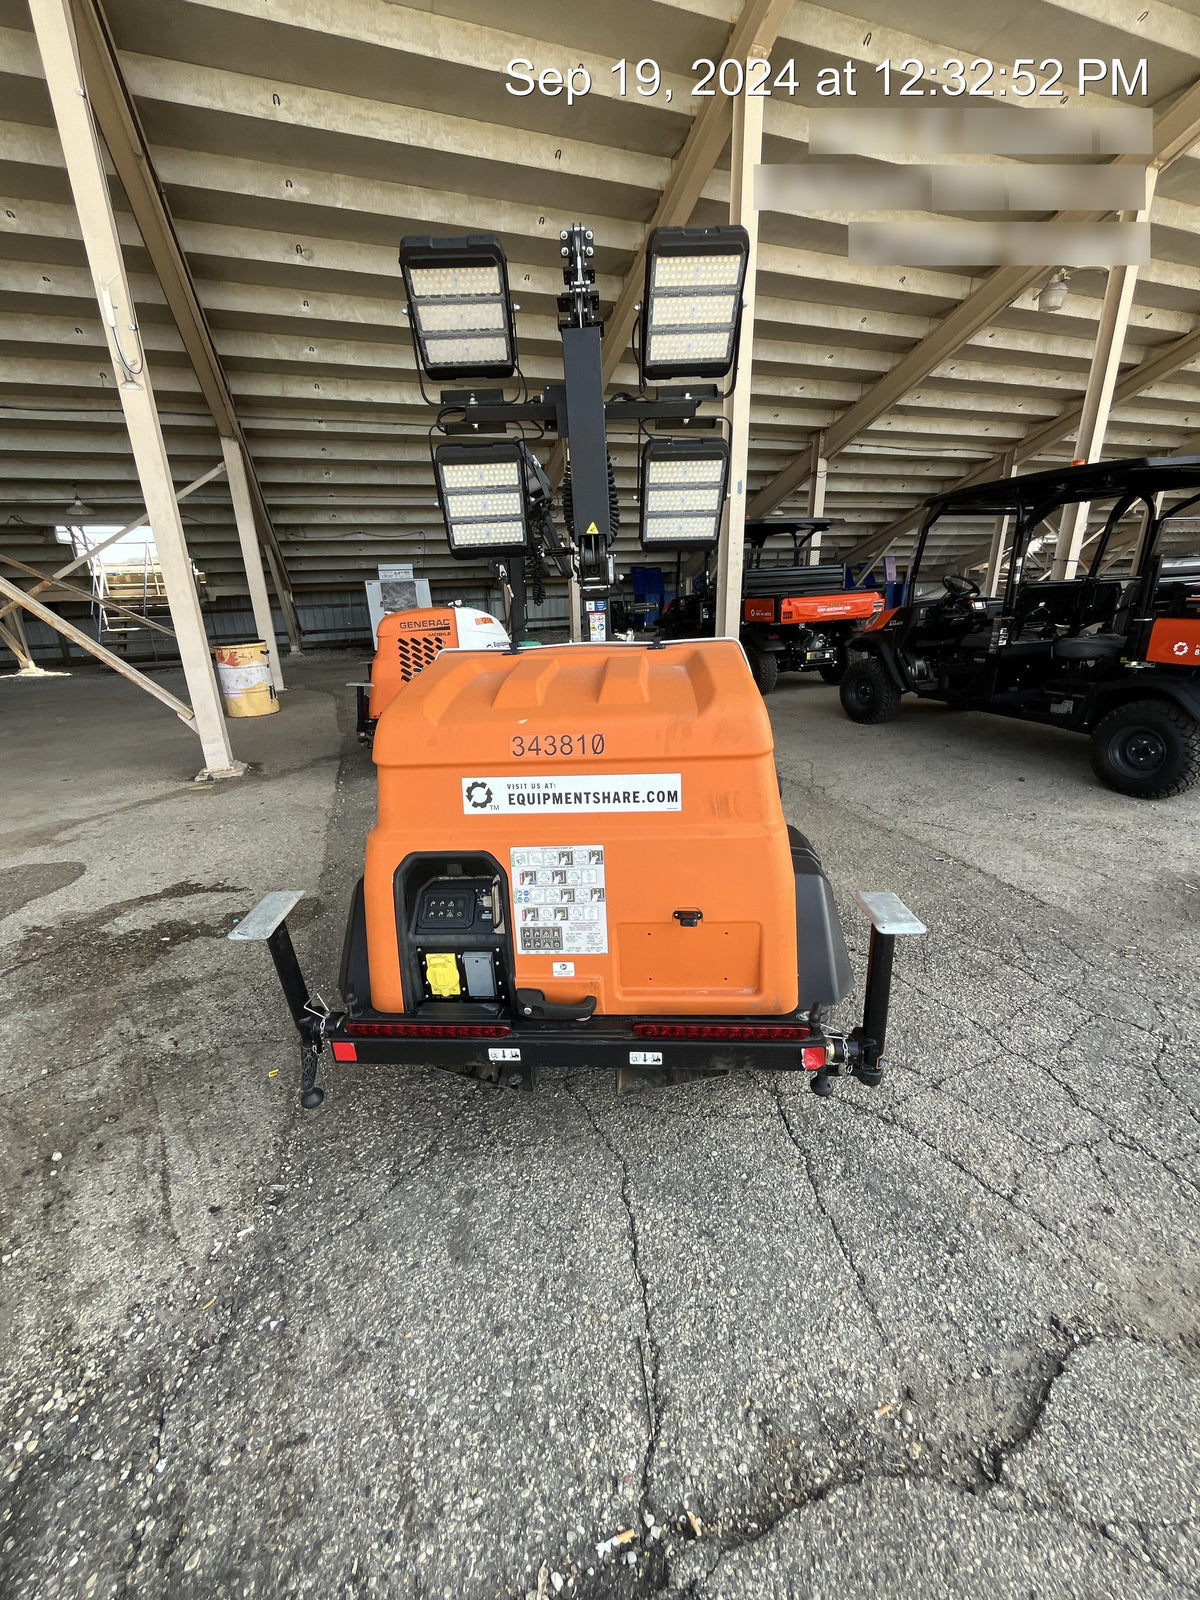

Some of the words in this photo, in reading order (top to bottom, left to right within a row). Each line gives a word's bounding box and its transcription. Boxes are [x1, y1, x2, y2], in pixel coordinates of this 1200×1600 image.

[399, 618, 450, 629] GENERAC
[512, 734, 605, 757] 343810
[506, 783, 527, 791] VISIT
[544, 782, 557, 790] AT:
[508, 790, 679, 806] EQUIPMENTSHARE.COM
